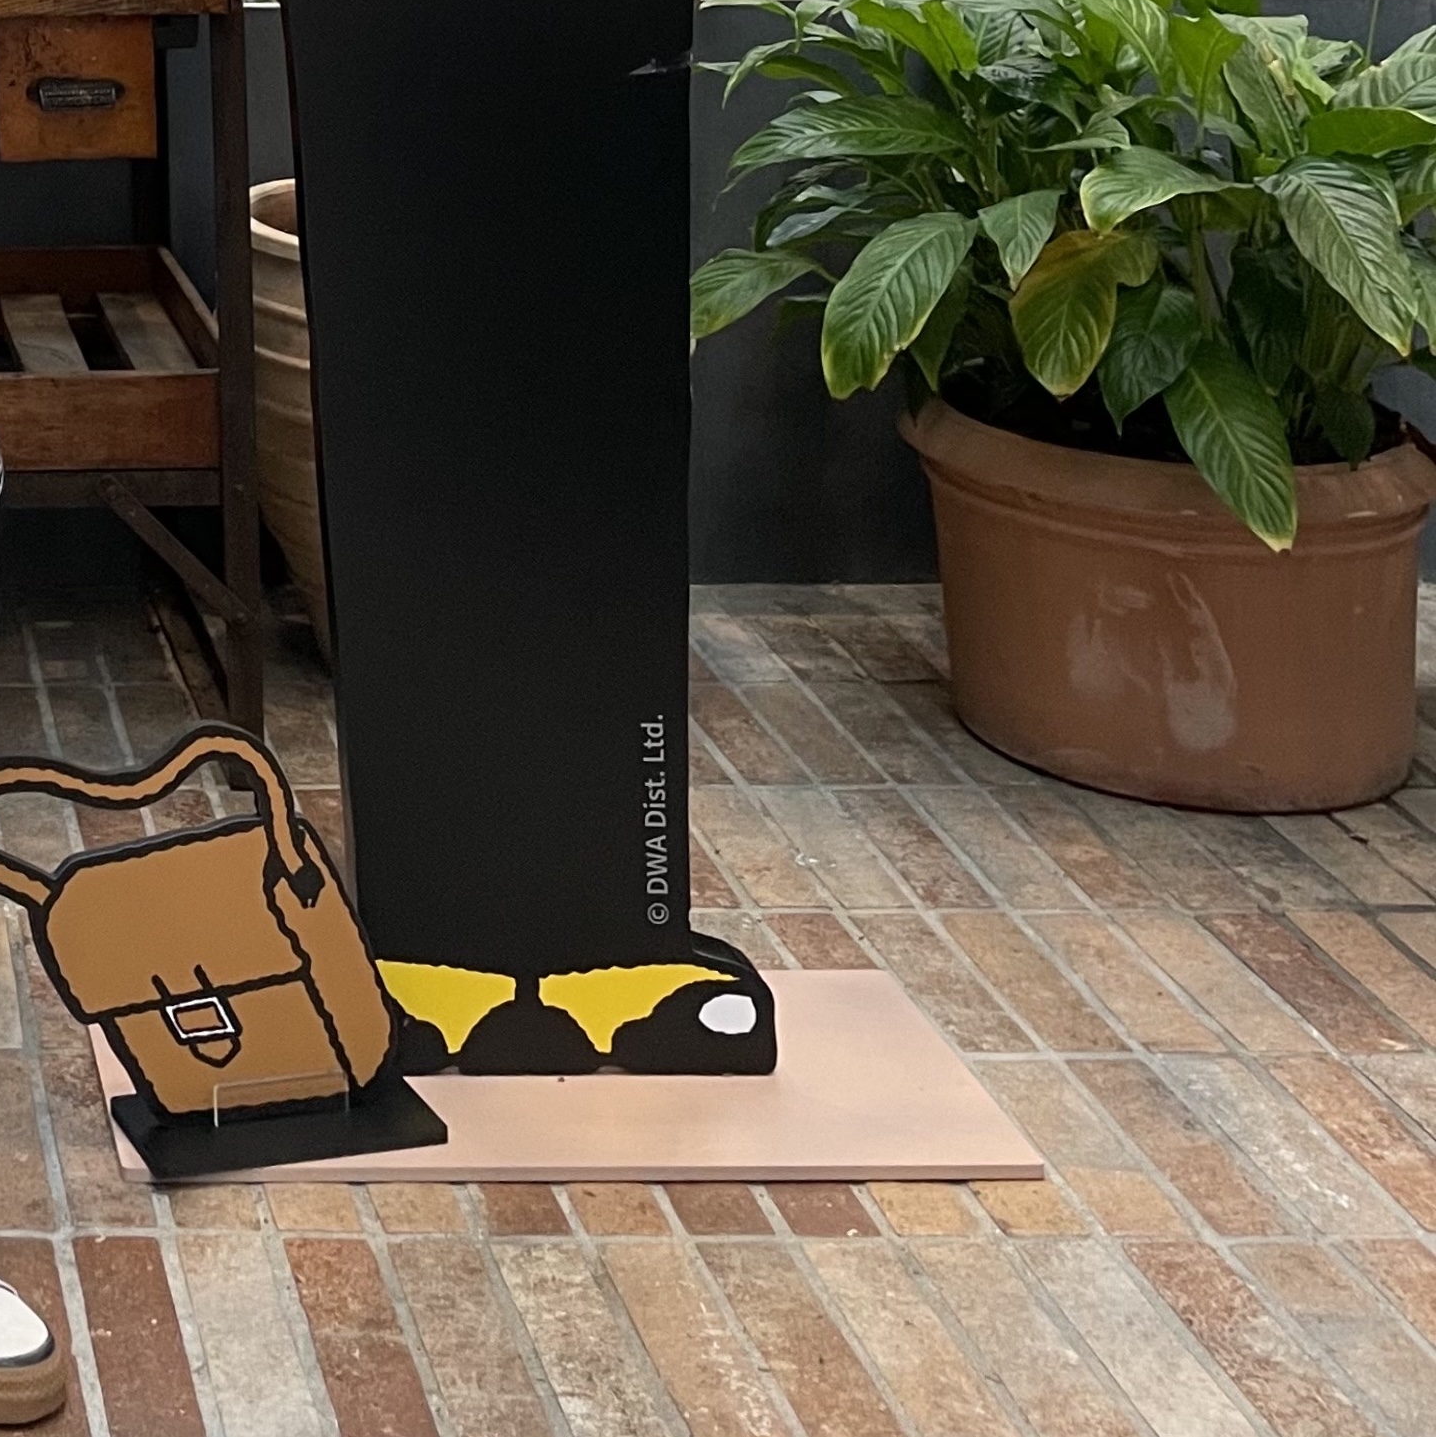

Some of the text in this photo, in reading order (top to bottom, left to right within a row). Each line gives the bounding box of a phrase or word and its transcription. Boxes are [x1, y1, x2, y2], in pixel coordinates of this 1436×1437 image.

[640, 714, 665, 763] Ltd.
[642, 771, 667, 827] Dist.
[646, 834, 669, 895] DWA
